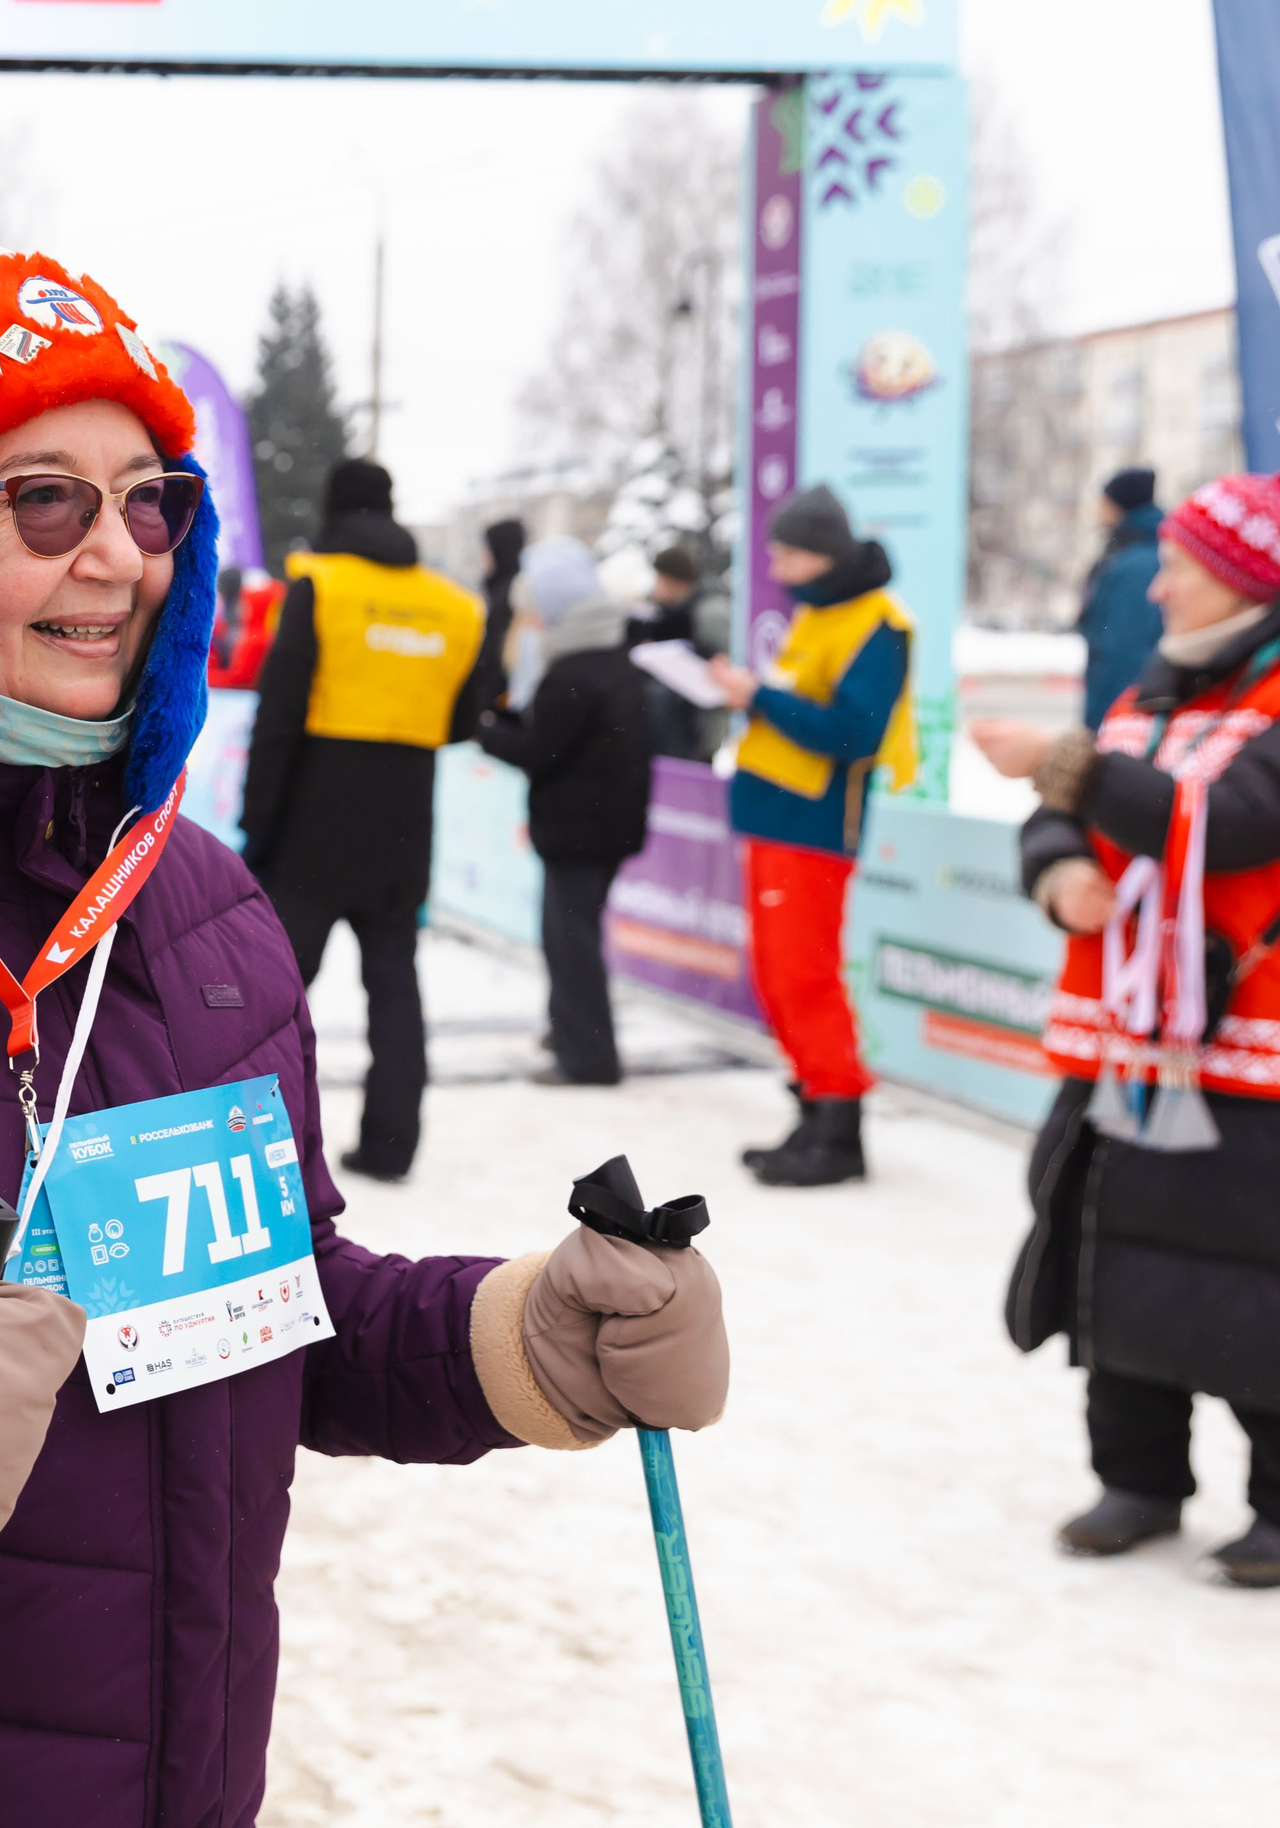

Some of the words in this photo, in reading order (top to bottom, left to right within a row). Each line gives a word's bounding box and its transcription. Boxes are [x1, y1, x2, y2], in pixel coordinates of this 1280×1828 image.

[69, 832, 155, 938] КАЛАШНИКОВ
[154, 782, 179, 833] СПОРТ
[139, 1119, 214, 1143] РОССЕЛЬХОЗБАНК
[71, 1142, 113, 1160] КУБОК
[278, 1175, 289, 1198] 5
[134, 1153, 271, 1276] 711
[280, 1198, 295, 1217] КМ
[154, 1359, 172, 1370] HAS
